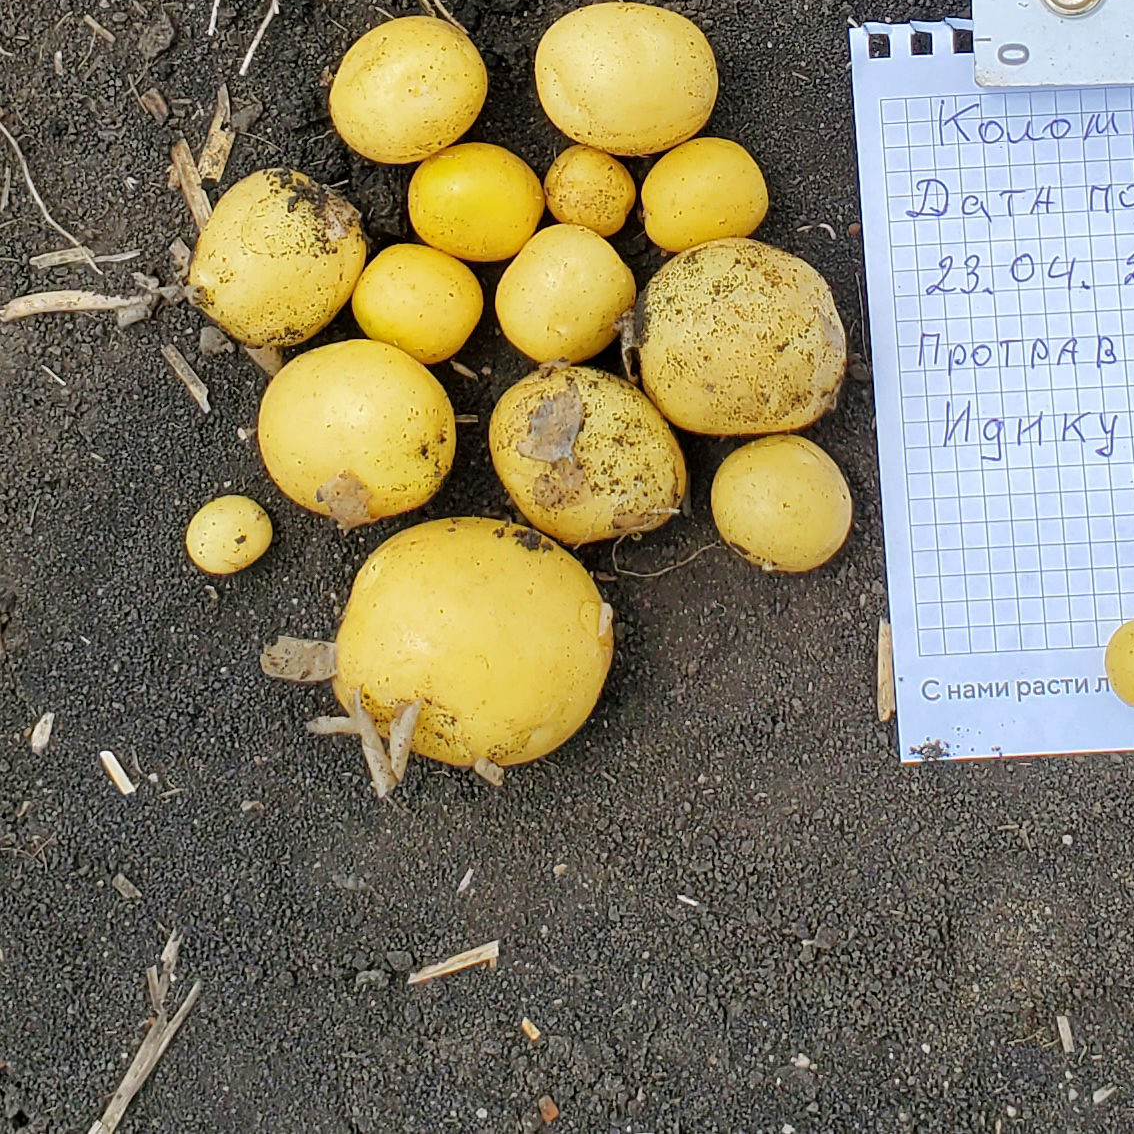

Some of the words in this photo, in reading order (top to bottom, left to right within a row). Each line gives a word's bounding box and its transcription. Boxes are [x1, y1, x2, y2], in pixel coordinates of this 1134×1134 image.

[997, 42, 1030, 66] 0
[905, 178, 1056, 223] Дата
[921, 679, 942, 701] С
[946, 680, 1010, 700] нами
[1016, 677, 1090, 702] расти
